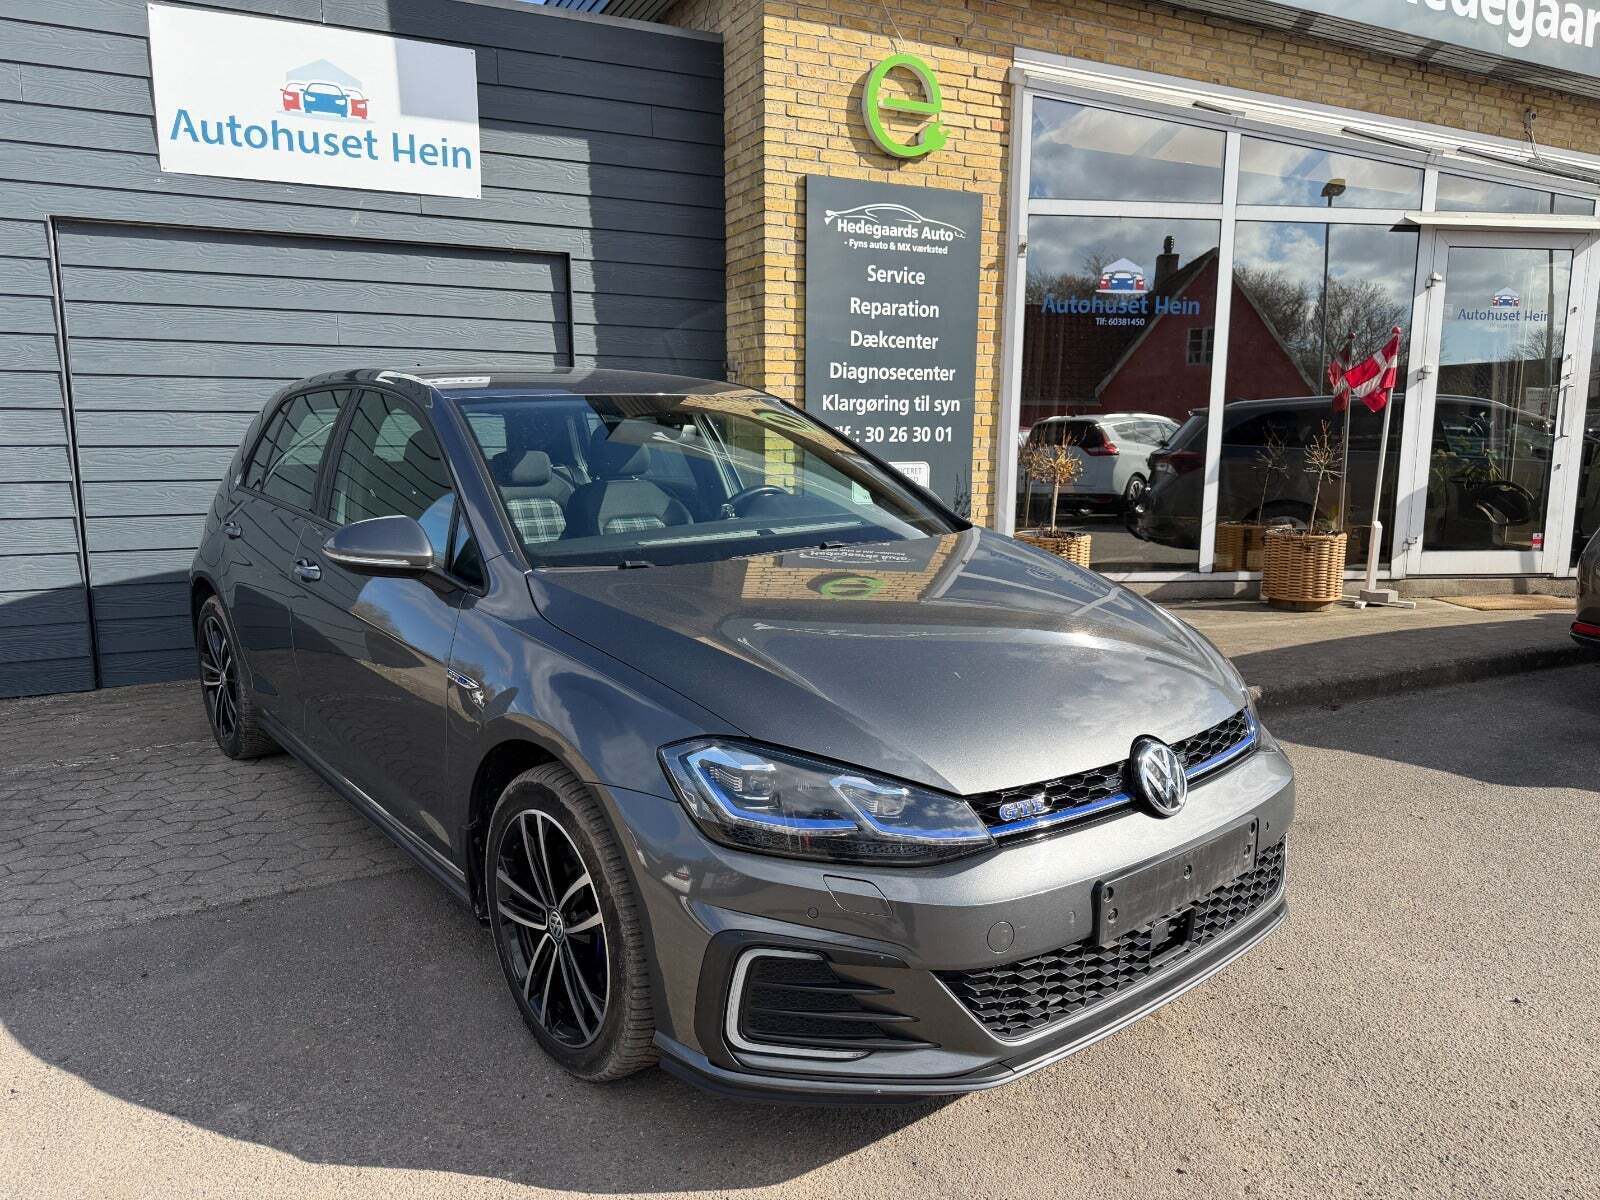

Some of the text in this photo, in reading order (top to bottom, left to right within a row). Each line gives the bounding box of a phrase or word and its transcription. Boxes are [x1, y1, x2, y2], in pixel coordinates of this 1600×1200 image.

[170, 108, 472, 170] Autohuset Hein
[837, 218, 954, 242] Hedegaards Auto
[849, 238, 868, 250] Fyns
[869, 240, 888, 250] auto
[889, 241, 896, 250] &
[897, 242, 911, 252] MX
[912, 243, 948, 255] værksted
[867, 264, 926, 285] Service
[850, 297, 940, 320] Reparation
[1041, 293, 1200, 315] Autohuset Hein
[1457, 308, 1521, 321] Autohuset
[1108, 317, 1145, 327] 60381450
[850, 330, 939, 350] Dækcenter
[829, 361, 956, 384] Diagnosecenter
[822, 393, 961, 416] Klargøring til syn
[865, 426, 885, 443] 30
[888, 426, 908, 443] 26
[912, 426, 931, 443] 30
[935, 426, 953, 443] 01
[1000, 797, 1046, 822] GTE
